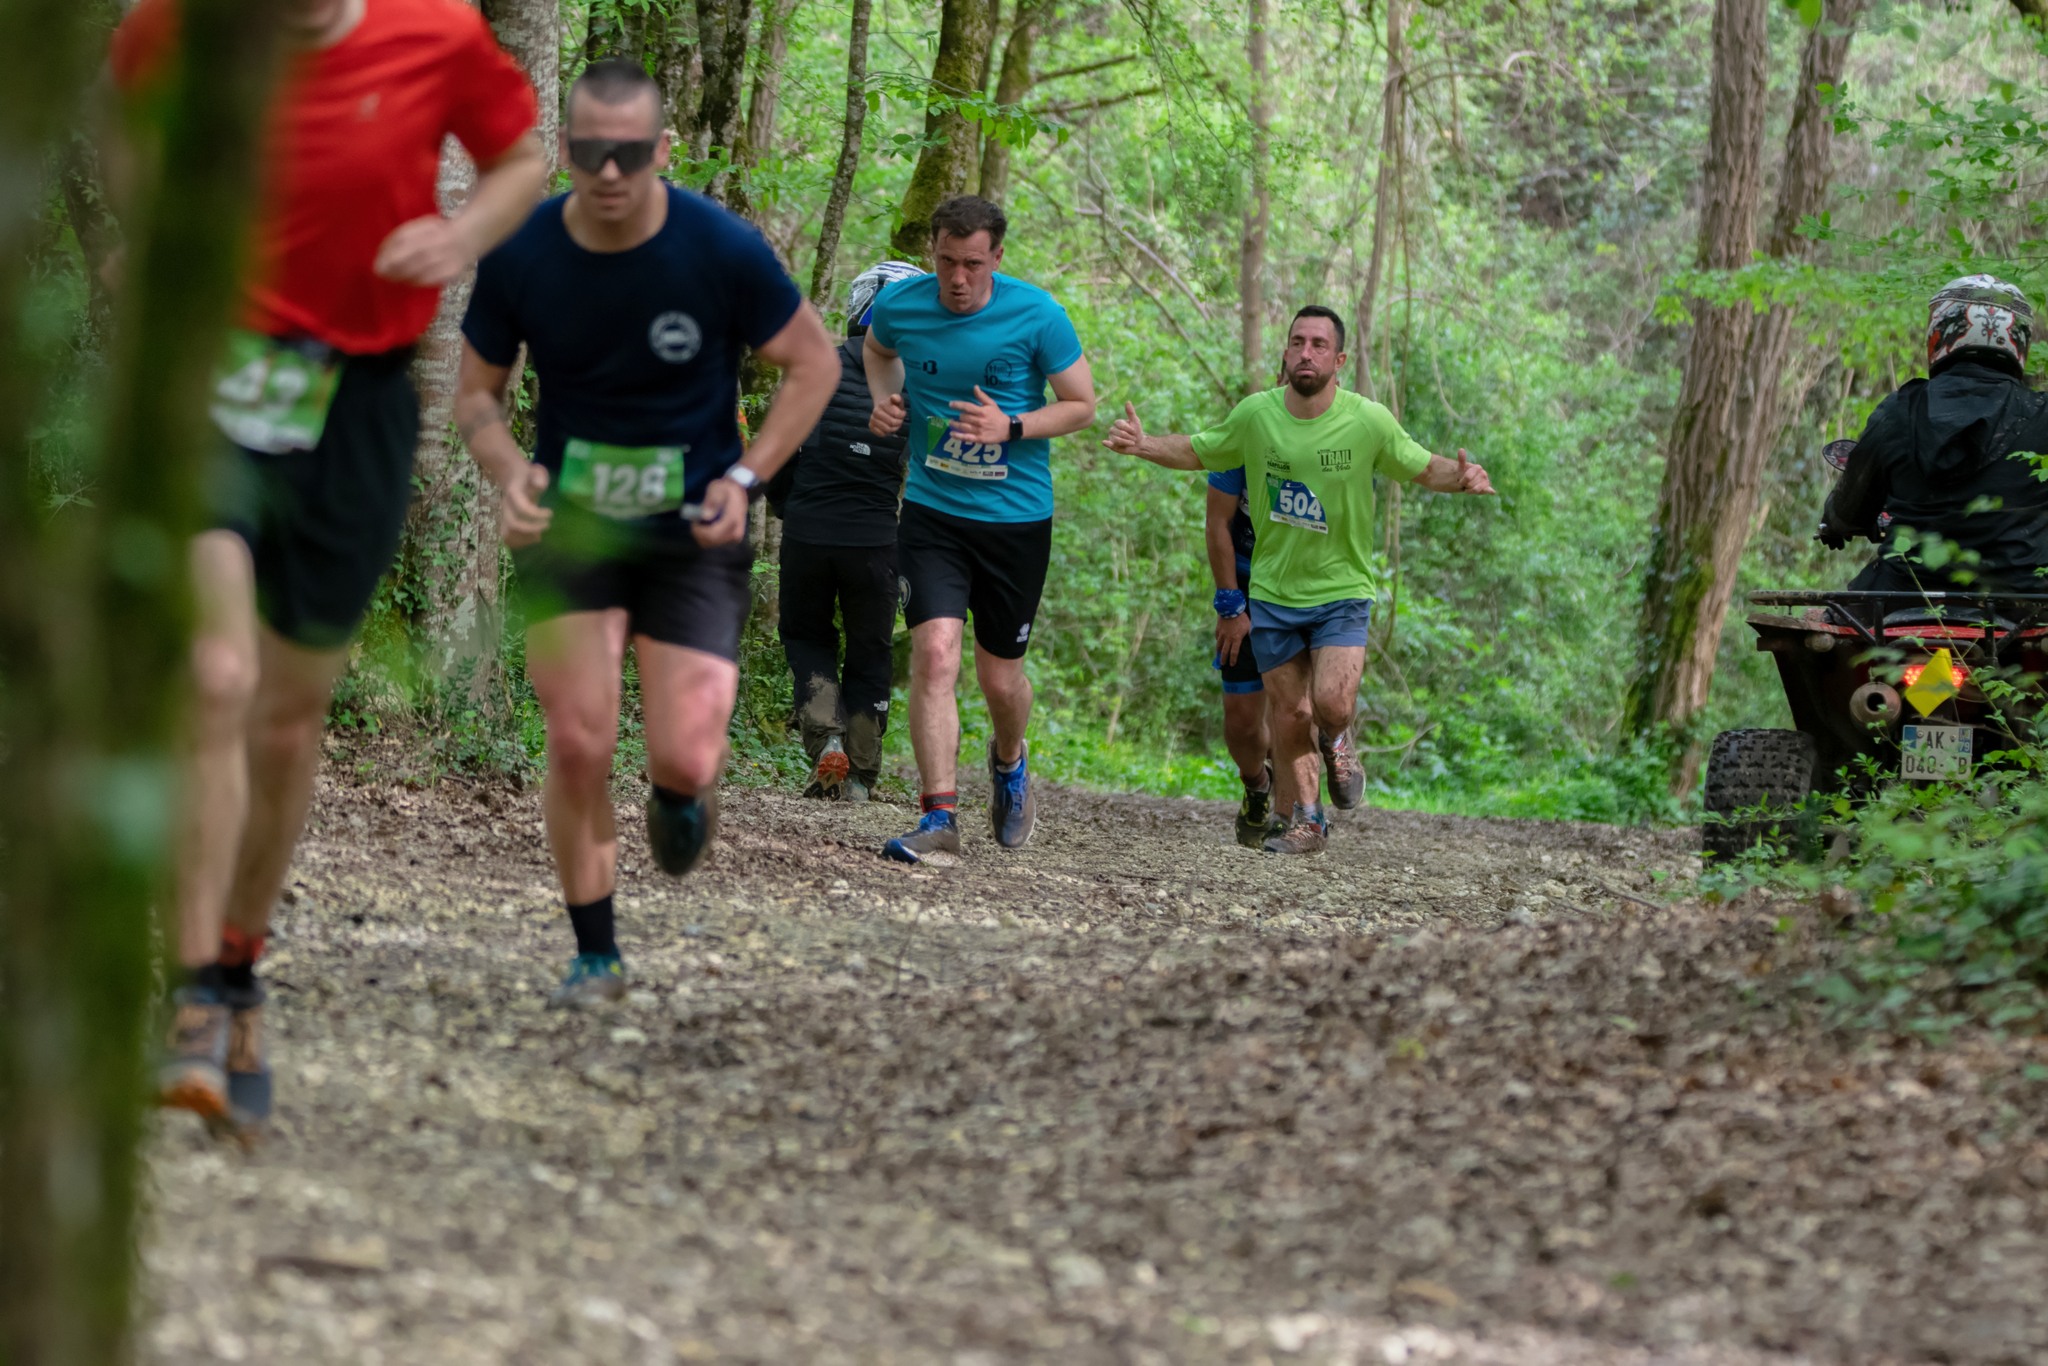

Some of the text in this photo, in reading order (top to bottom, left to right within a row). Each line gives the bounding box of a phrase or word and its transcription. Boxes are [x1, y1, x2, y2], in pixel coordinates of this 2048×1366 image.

[943, 434, 1003, 464] 425
[1320, 449, 1351, 466] TRAIL
[592, 462, 668, 506] 128
[1280, 489, 1322, 520] 504
[1926, 731, 1945, 749] AK
